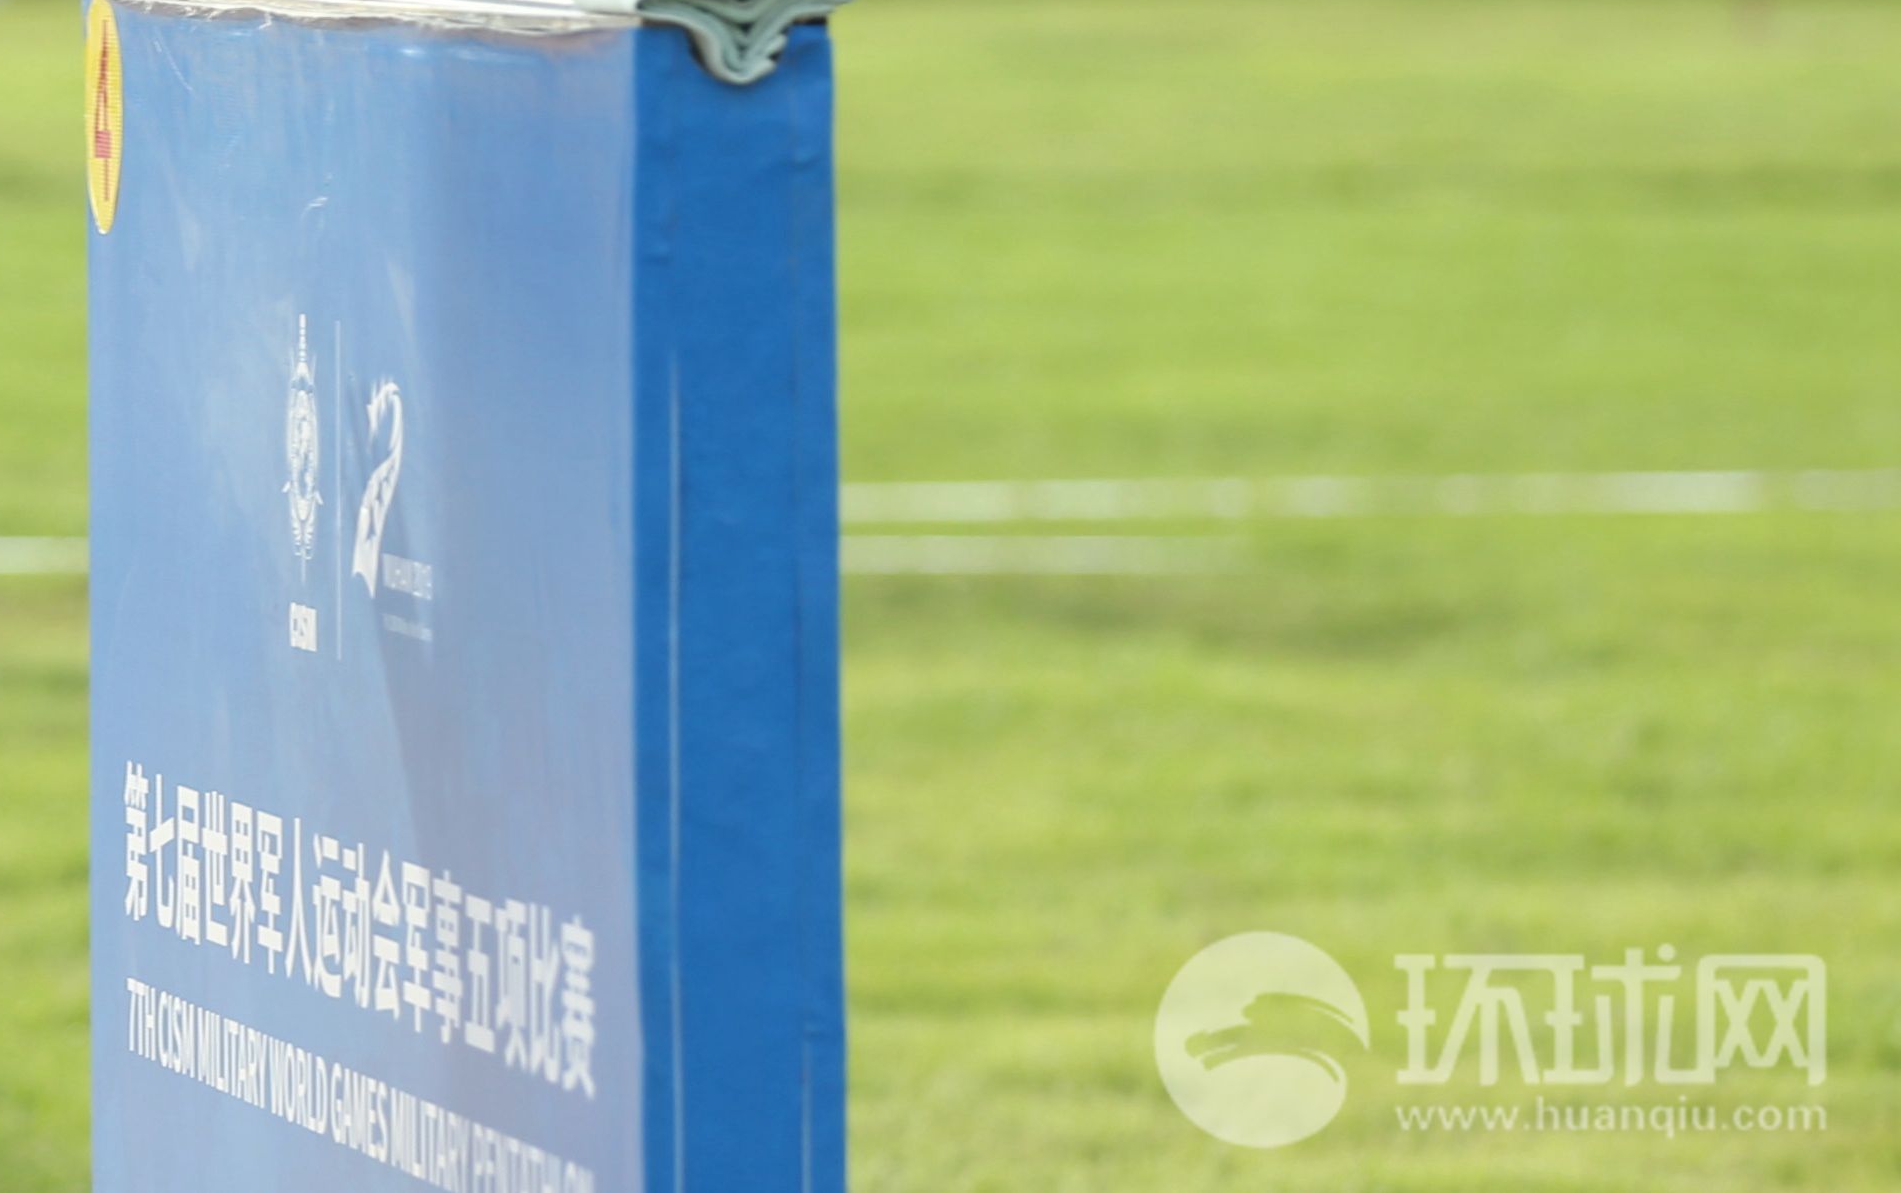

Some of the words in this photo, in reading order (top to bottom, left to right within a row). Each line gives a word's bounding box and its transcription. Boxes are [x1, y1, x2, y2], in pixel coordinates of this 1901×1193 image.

[94, 18, 111, 203] 4
[124, 759, 596, 1101] 第七届世界军人运动会军事五项比赛
[126, 977, 157, 1061] 7TH
[158, 990, 195, 1078] CISM
[197, 1006, 268, 1109] MILITARY
[269, 1036, 328, 1135] WORLD
[330, 1062, 389, 1163] GAMES
[390, 1086, 471, 1193] MILITARY
